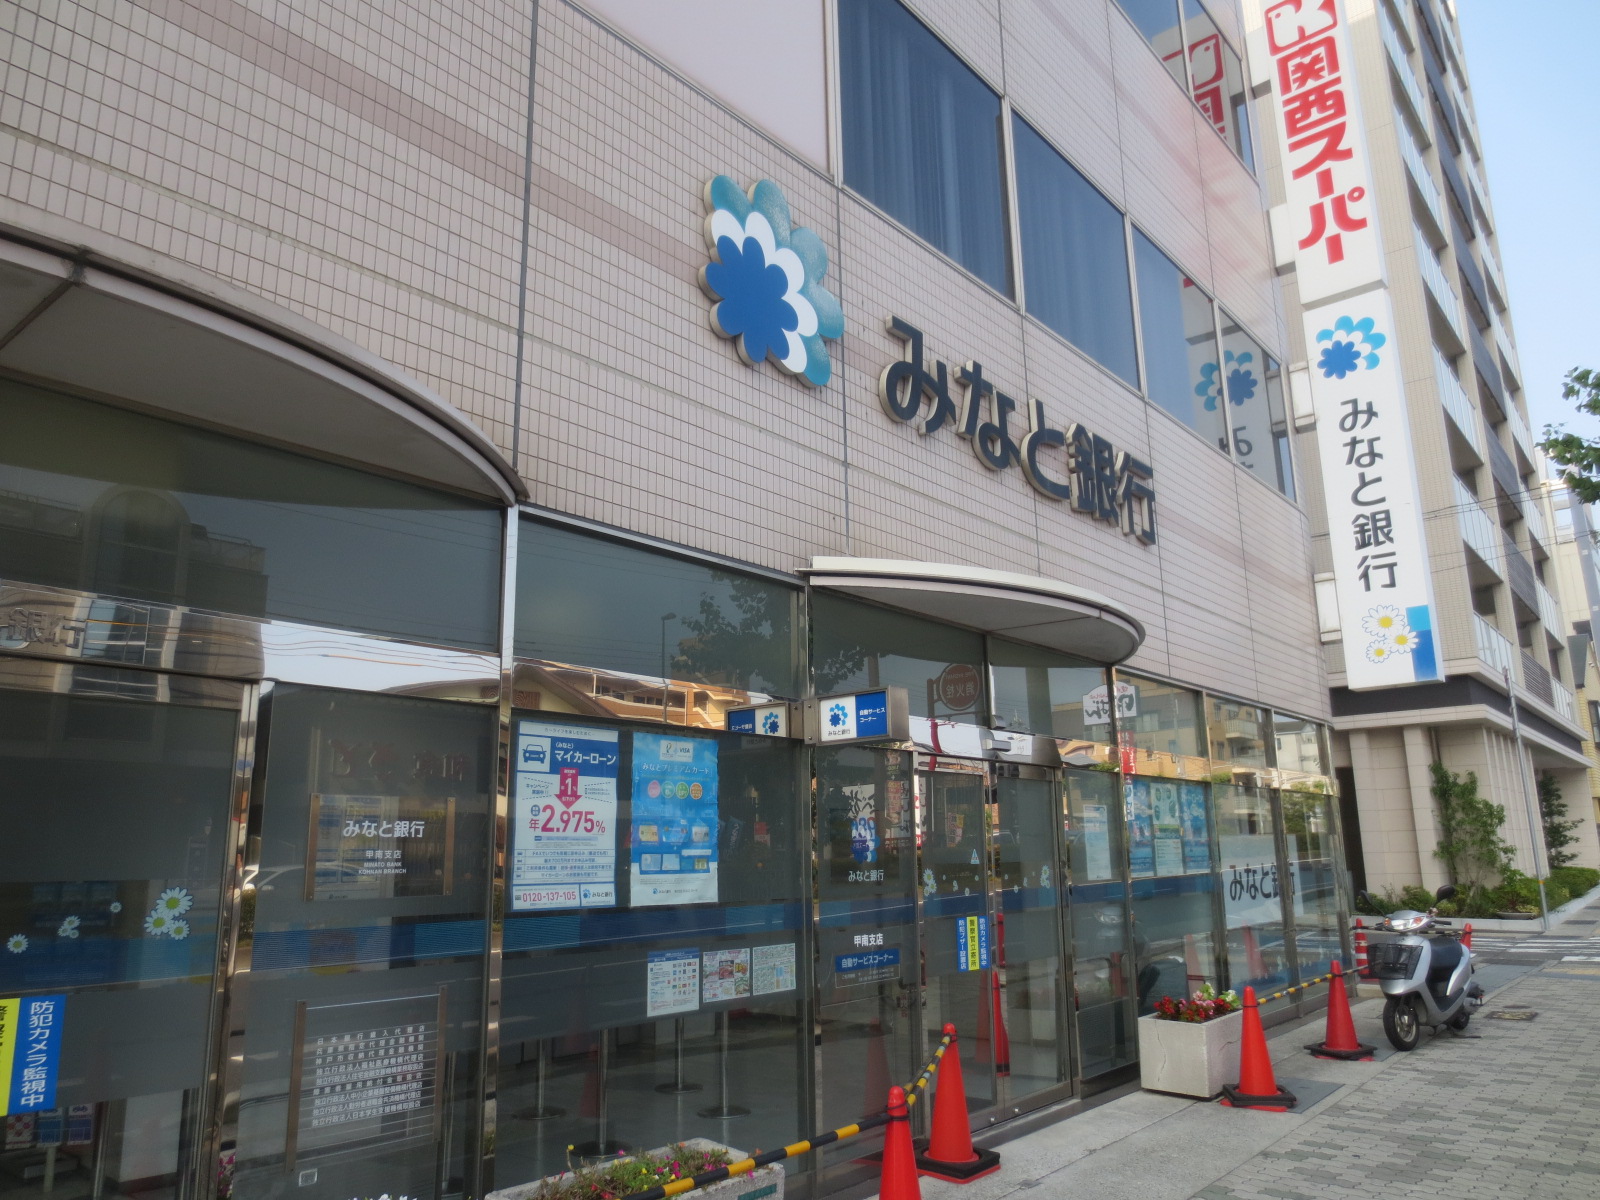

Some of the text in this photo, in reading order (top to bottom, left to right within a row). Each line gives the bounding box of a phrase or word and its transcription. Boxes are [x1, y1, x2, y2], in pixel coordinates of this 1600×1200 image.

[1276, 35, 1368, 265] 関西スーパー
[879, 315, 1157, 546] みなと銀行
[1339, 397, 1398, 592] みなと銀行
[859, 707, 886, 716] 自動サービス
[554, 750, 616, 765] マイカーローン
[343, 820, 425, 838] みなと銀行
[365, 850, 402, 859] 甲南支店
[848, 870, 884, 881] みなと銀行
[522, 891, 576, 902] 0120-137-105
[854, 933, 884, 947] 甲南支店
[842, 954, 894, 968] 自動サービスコーナー
[20, 1000, 55, 1108] 防犯カメラ監視中
